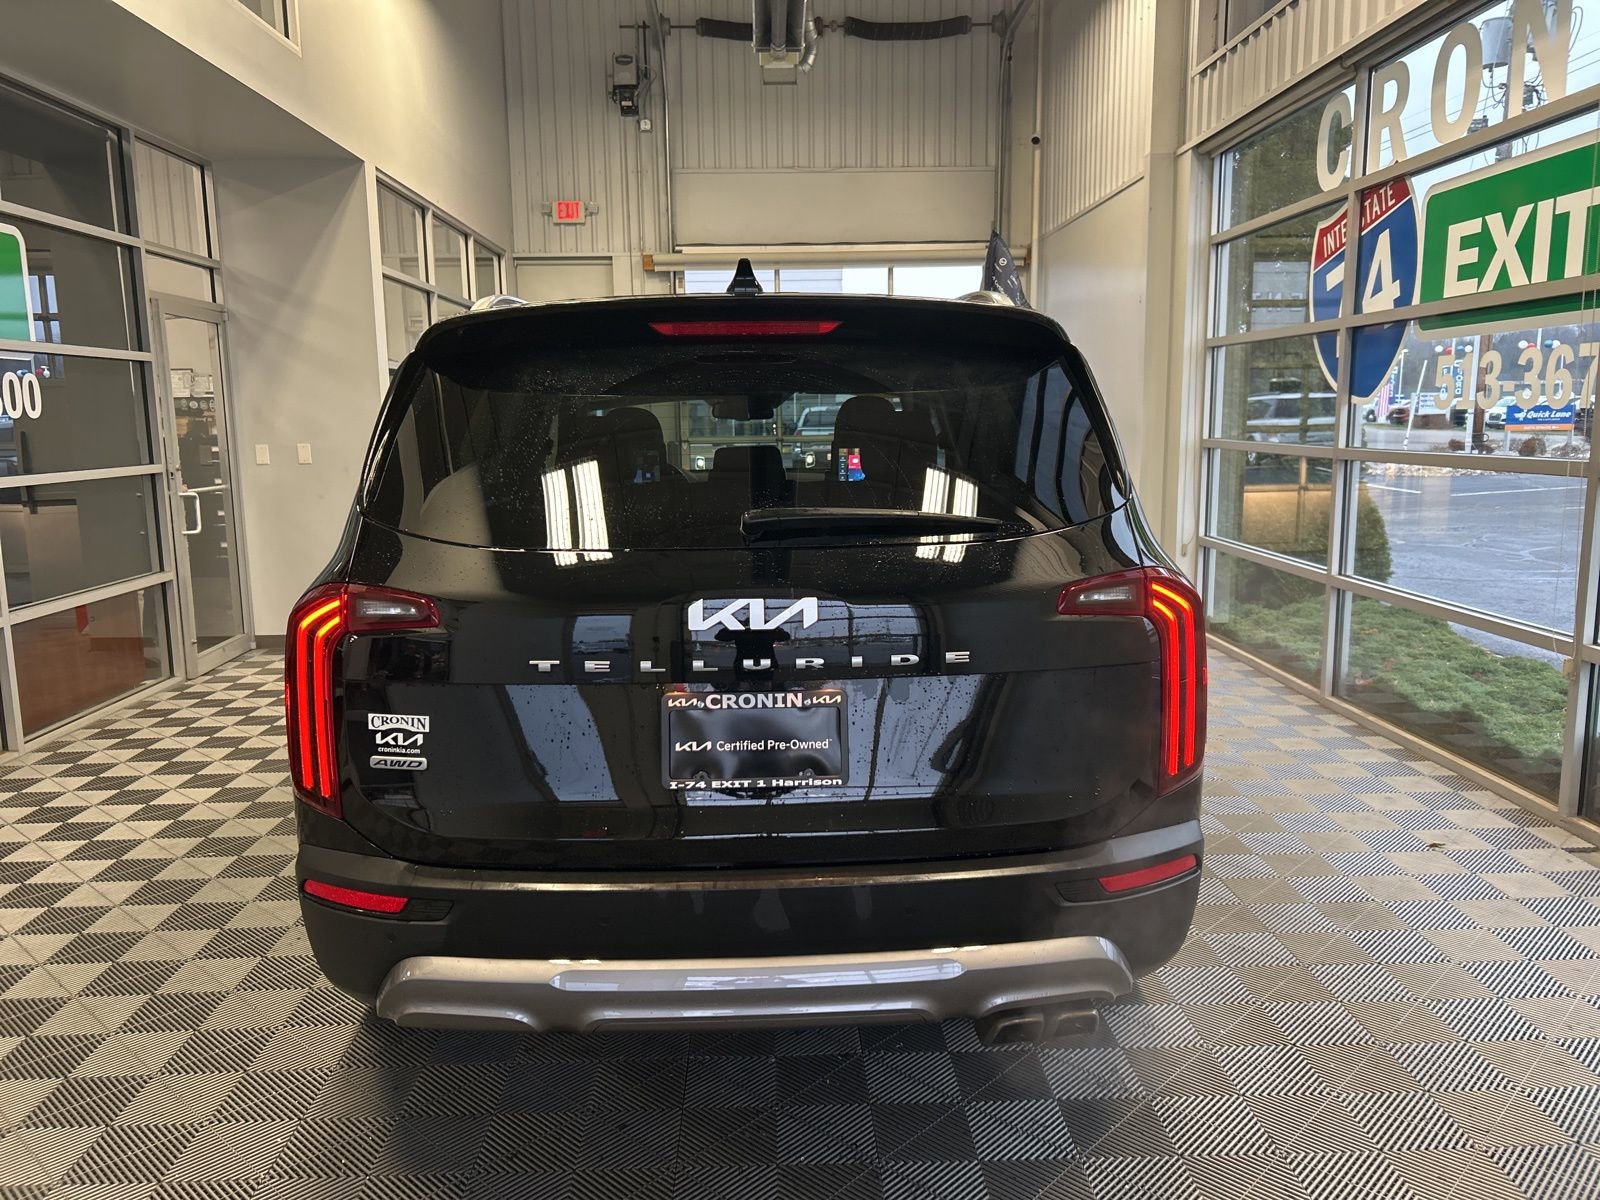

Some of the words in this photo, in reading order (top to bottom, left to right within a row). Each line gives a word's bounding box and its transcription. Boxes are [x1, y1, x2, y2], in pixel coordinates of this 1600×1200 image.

[557, 201, 580, 219] EXIT
[1323, 181, 1396, 258] INTETATE
[1443, 185, 1600, 298] EXIT
[0, 371, 42, 419] 00
[1526, 410, 1550, 418] Quick
[688, 597, 818, 630] KIA
[529, 651, 970, 674] TELLURIDE
[705, 692, 803, 709] CRONIN
[371, 715, 427, 731] CRONIN
[375, 732, 424, 747] KIA
[716, 739, 765, 751] Certified
[373, 759, 423, 768] AWD
[711, 780, 751, 788] EXIT
[756, 779, 766, 787] 1
[771, 778, 843, 787] Harrison
